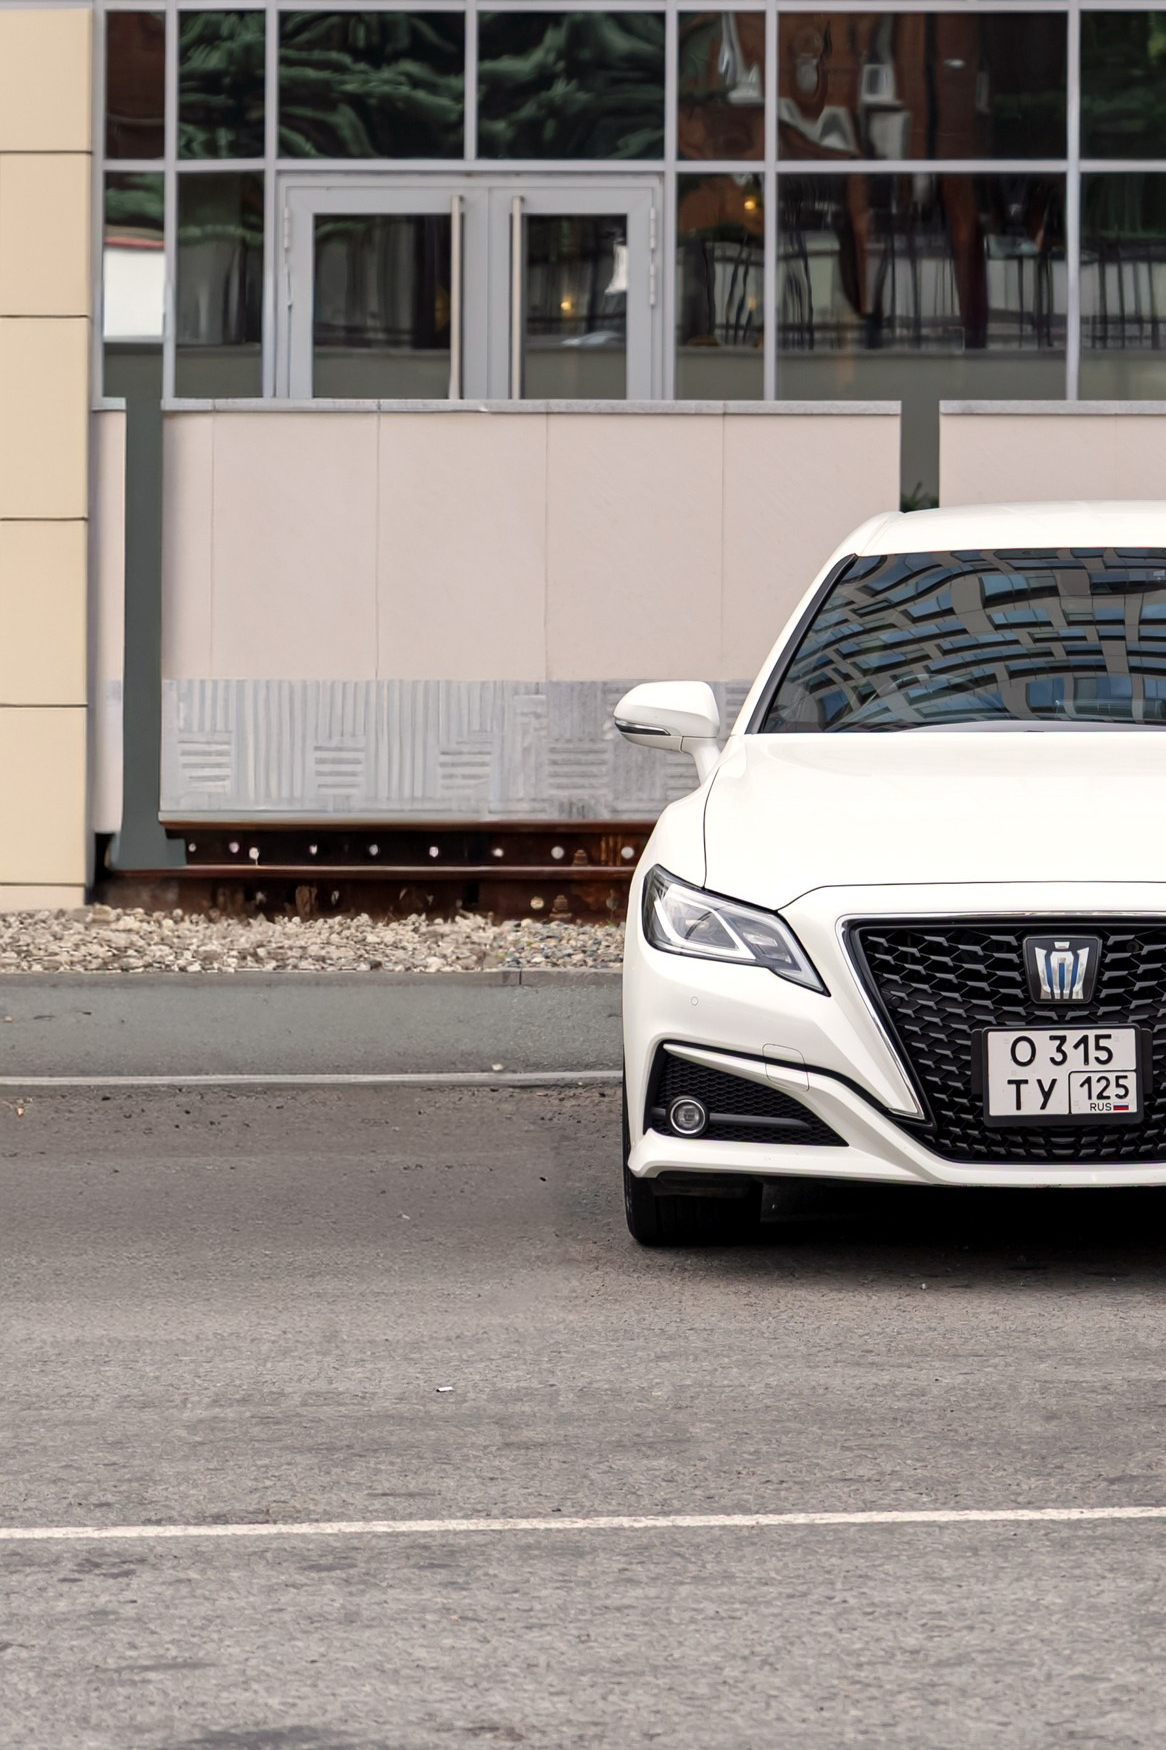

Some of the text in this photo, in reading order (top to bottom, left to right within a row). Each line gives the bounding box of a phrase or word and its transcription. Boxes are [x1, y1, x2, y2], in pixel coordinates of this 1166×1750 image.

[1049, 1034, 1113, 1066] 315
[1079, 1075, 1129, 1100] 125
[1090, 1103, 1112, 1111] RUS
